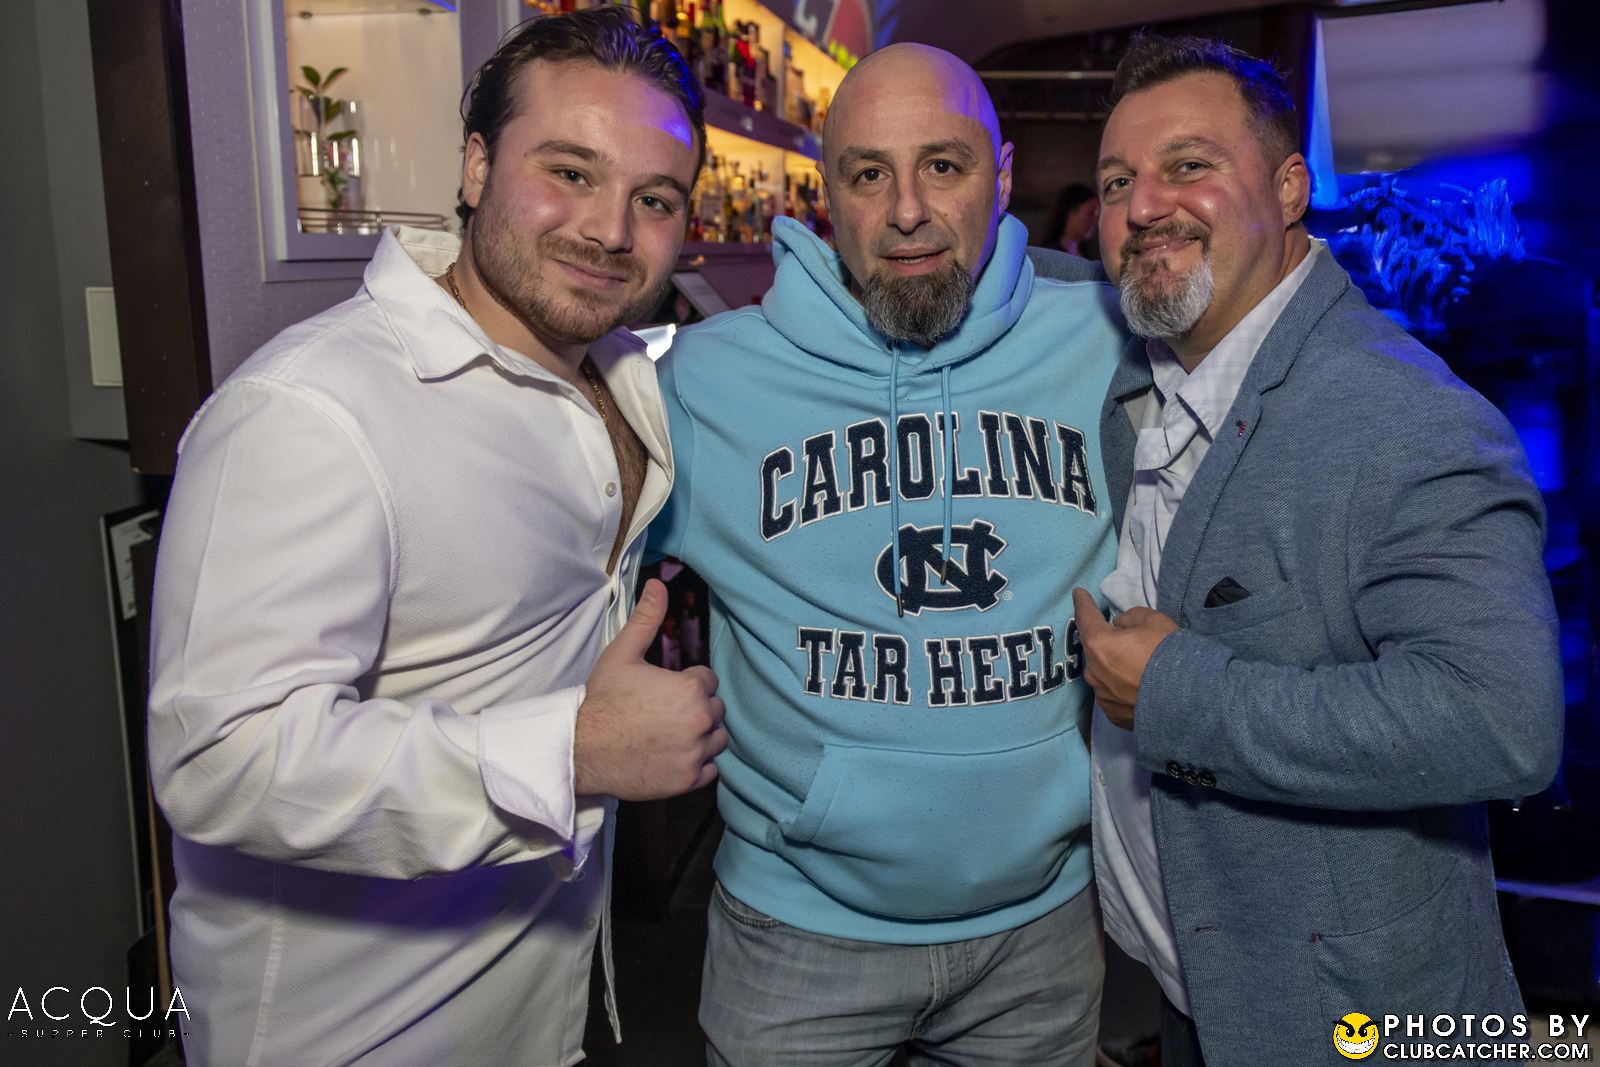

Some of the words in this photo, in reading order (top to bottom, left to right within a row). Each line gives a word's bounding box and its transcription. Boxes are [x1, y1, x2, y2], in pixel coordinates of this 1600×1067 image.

[760, 410, 1096, 541] CAROLINA
[797, 626, 911, 705] TAR
[925, 617, 1083, 707] HEELS
